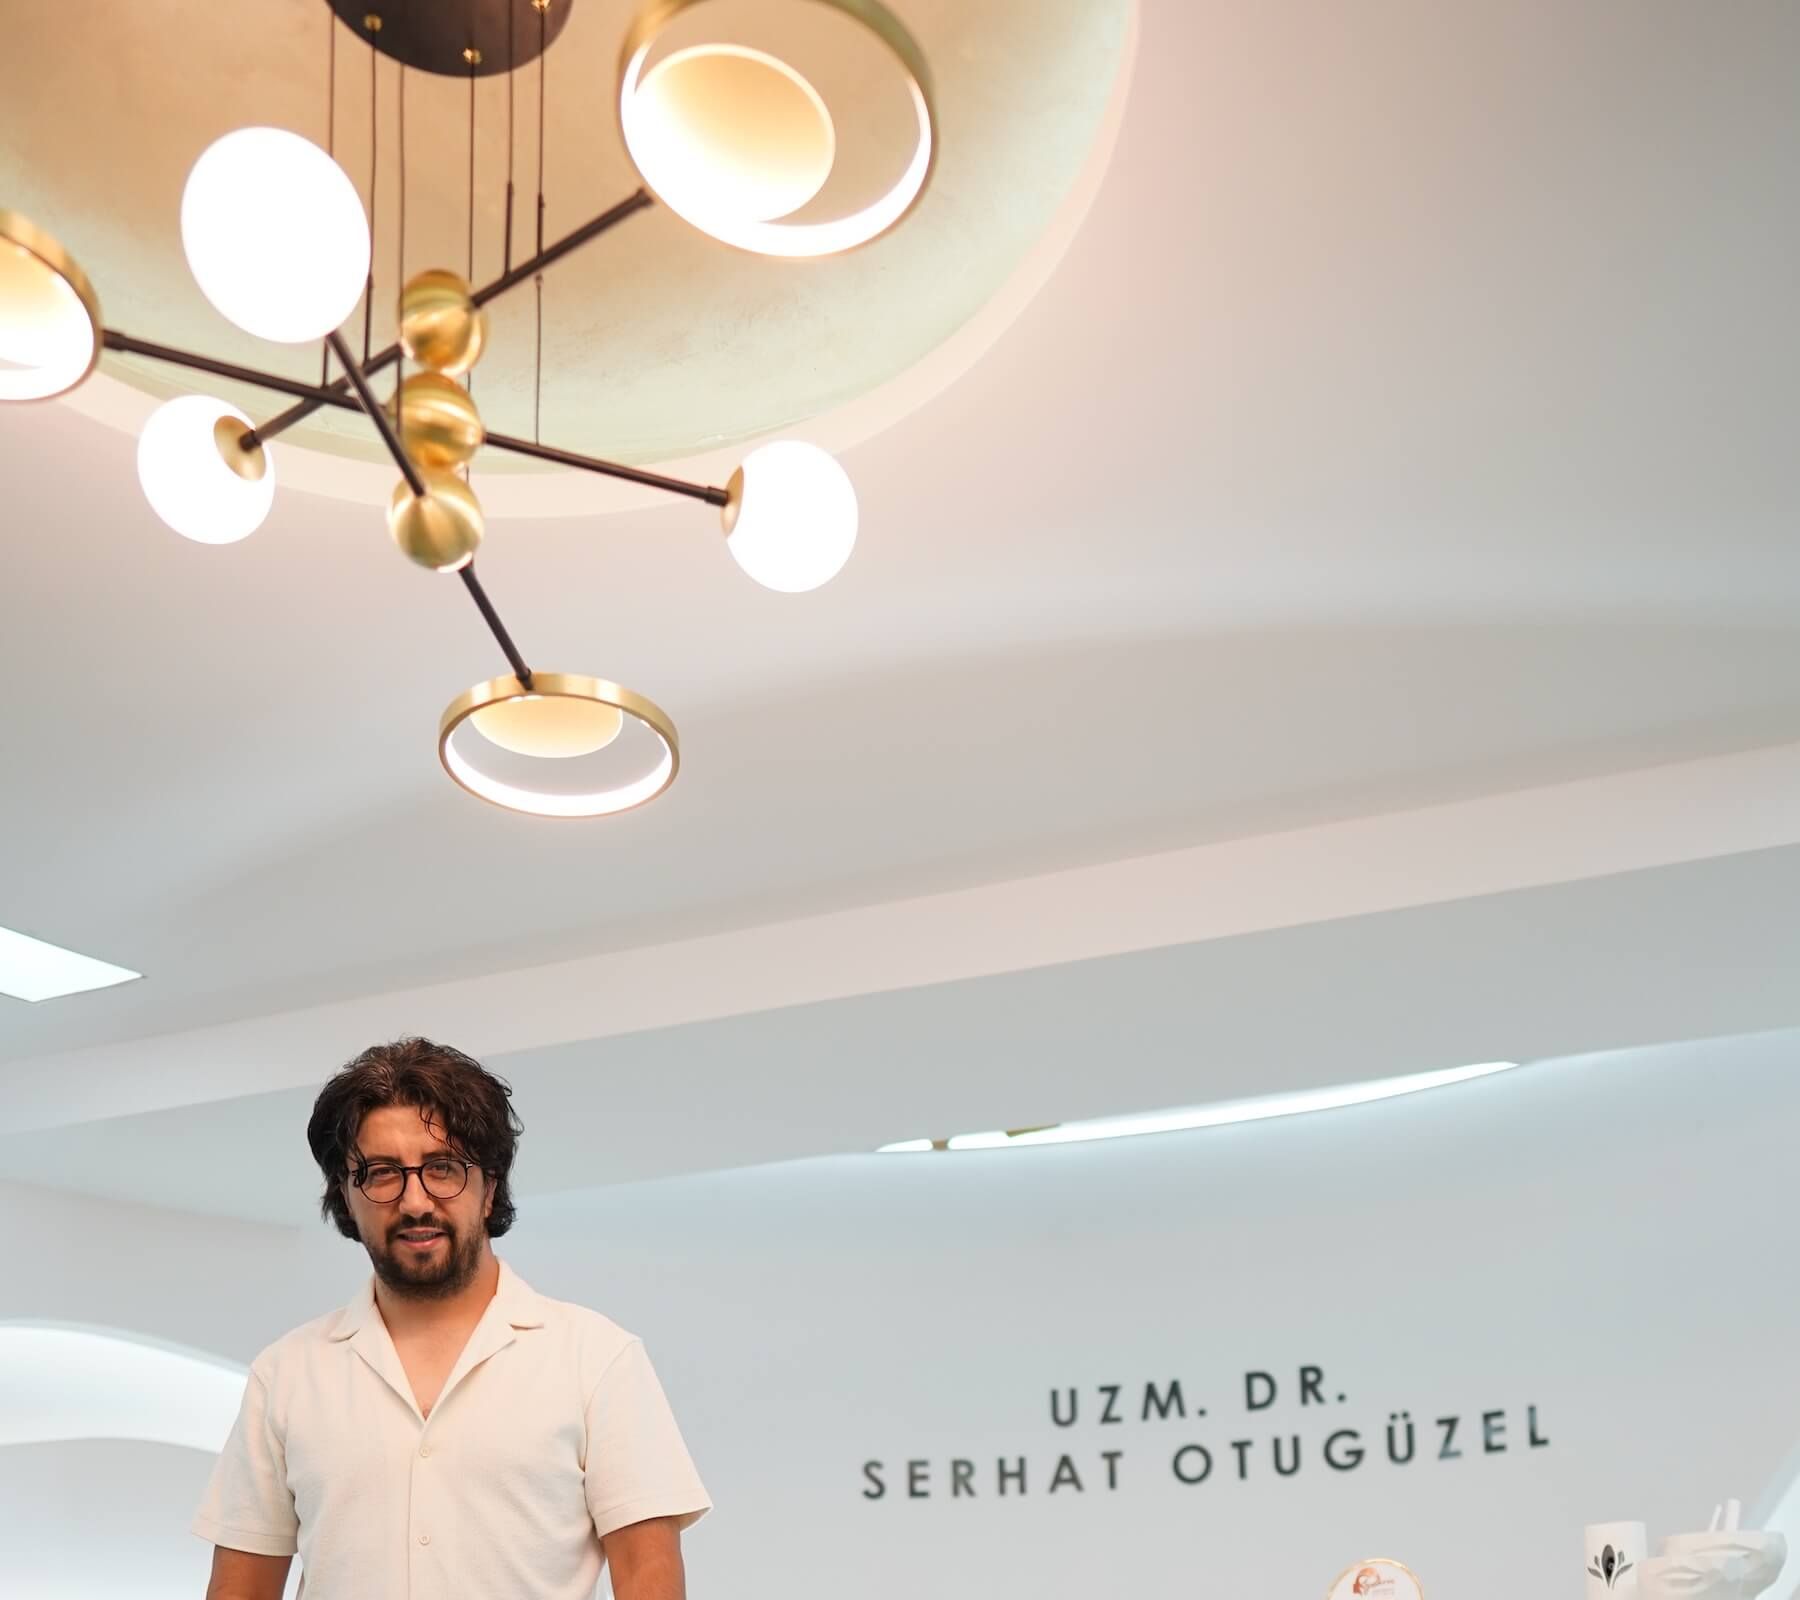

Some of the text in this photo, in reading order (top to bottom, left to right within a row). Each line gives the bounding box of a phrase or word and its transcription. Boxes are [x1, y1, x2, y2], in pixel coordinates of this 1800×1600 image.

[1050, 1365, 1347, 1428] UZM. DR.
[862, 1406, 1550, 1499] SERHAT OTUGÜZEL
